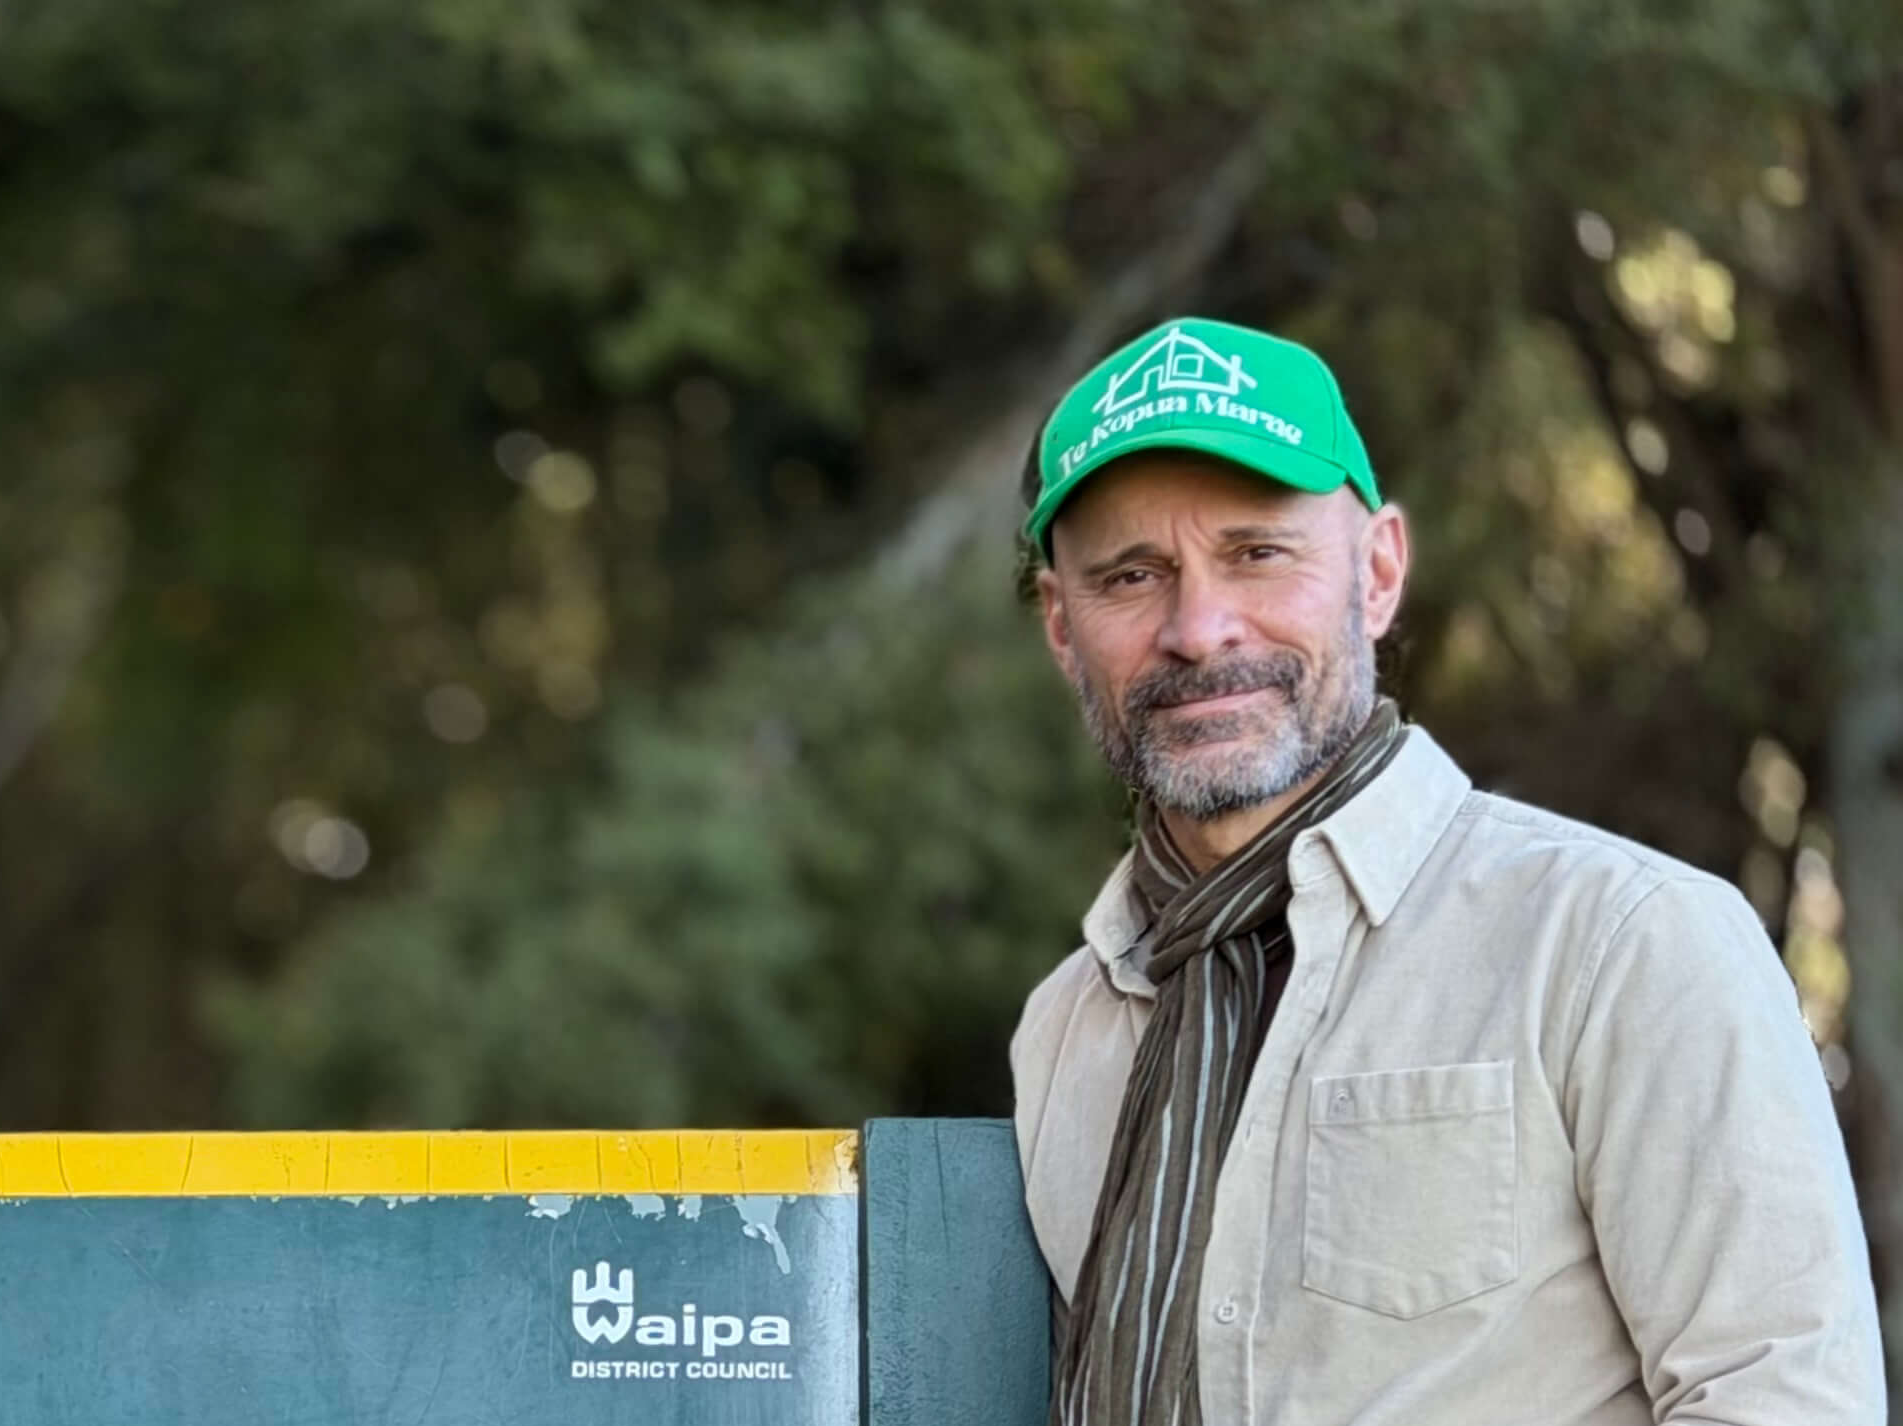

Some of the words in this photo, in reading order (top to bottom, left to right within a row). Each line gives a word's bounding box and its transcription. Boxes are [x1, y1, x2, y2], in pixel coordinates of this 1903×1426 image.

[1059, 441, 1088, 479] Te
[1090, 396, 1188, 449] Kopua
[1195, 392, 1304, 446] Marae
[571, 1301, 793, 1357] Waipa
[571, 1360, 680, 1379] DISTRICT
[685, 1361, 793, 1380] COUNCIL
